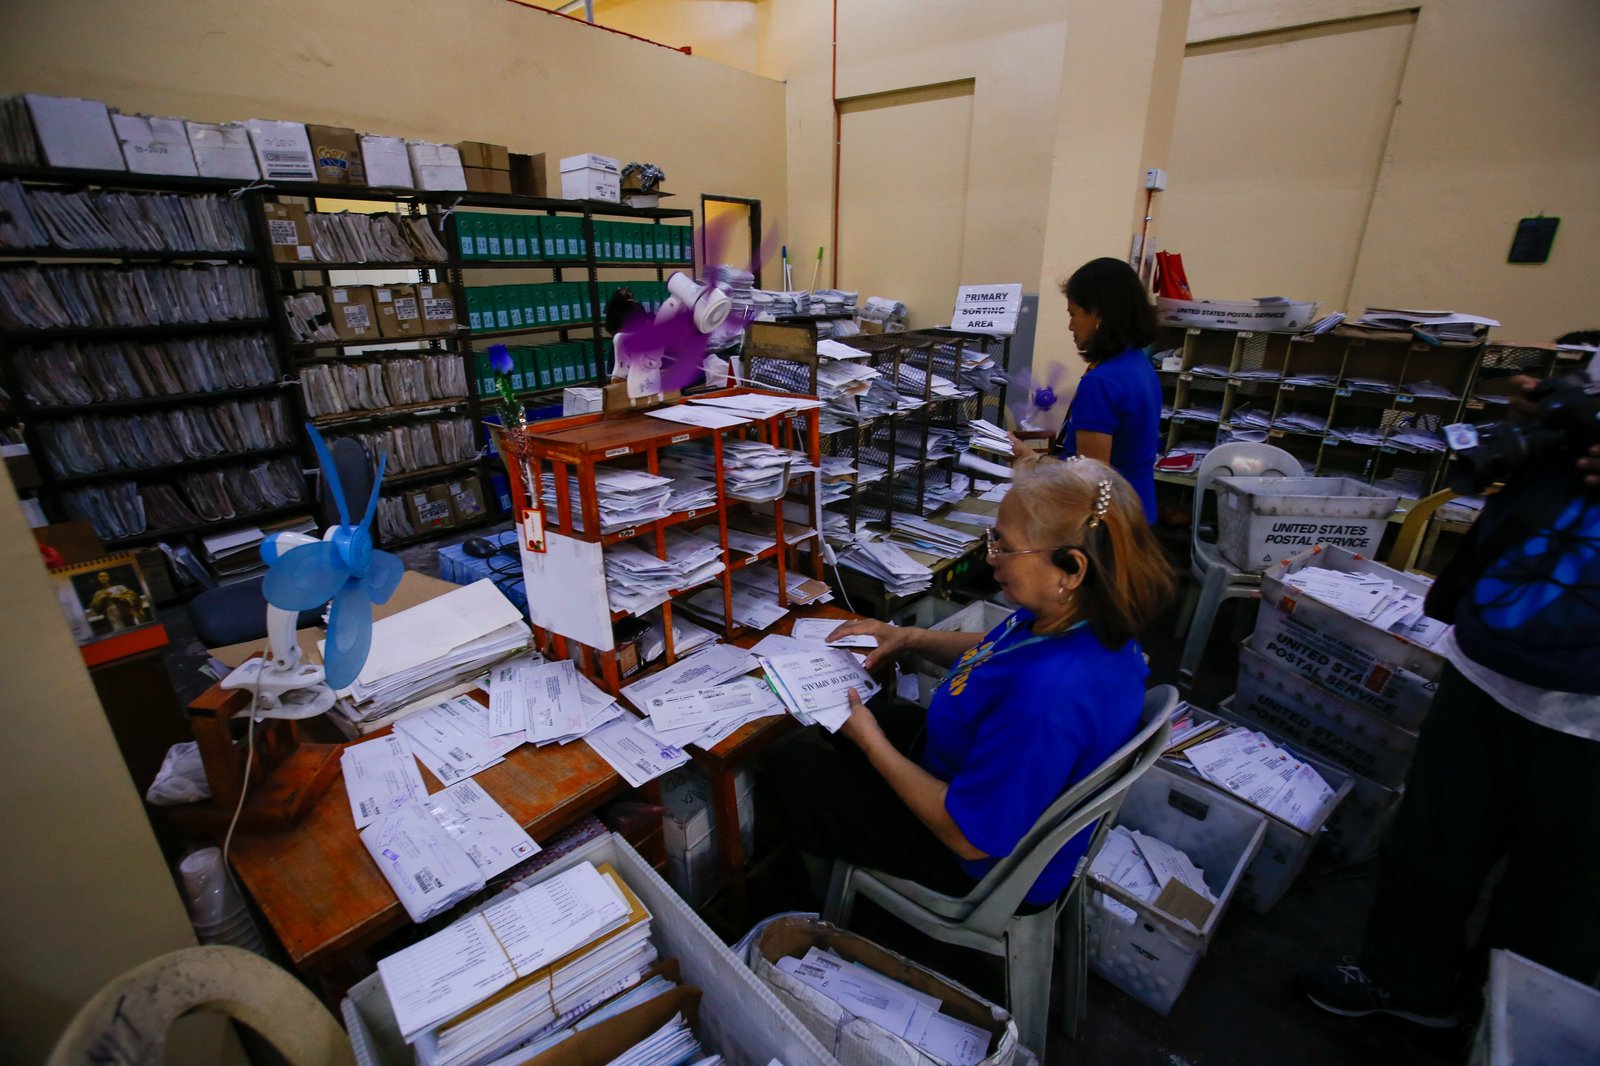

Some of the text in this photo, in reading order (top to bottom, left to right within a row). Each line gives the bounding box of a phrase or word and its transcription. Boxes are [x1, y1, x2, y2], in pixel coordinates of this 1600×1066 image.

[964, 292, 1009, 302] PRIMARY
[962, 306, 1006, 315] SORTING
[1176, 307, 1201, 315] UNITED
[1201, 309, 1226, 317] STATES
[967, 320, 994, 328] AREA
[1272, 522, 1368, 536] UNITED STATES
[1265, 534, 1313, 546] POSTAL
[1276, 632, 1330, 666] UNITED
[1331, 661, 1398, 699] STAS
[830, 677, 840, 685] OF
[839, 672, 860, 683] COURT
[1265, 641, 1321, 678] POSTAL
[1324, 674, 1399, 716] SERVICE
[801, 679, 830, 692] APPEALS
[1247, 703, 1301, 741] POSTAL
[1257, 693, 1376, 764] UNITED STATES
